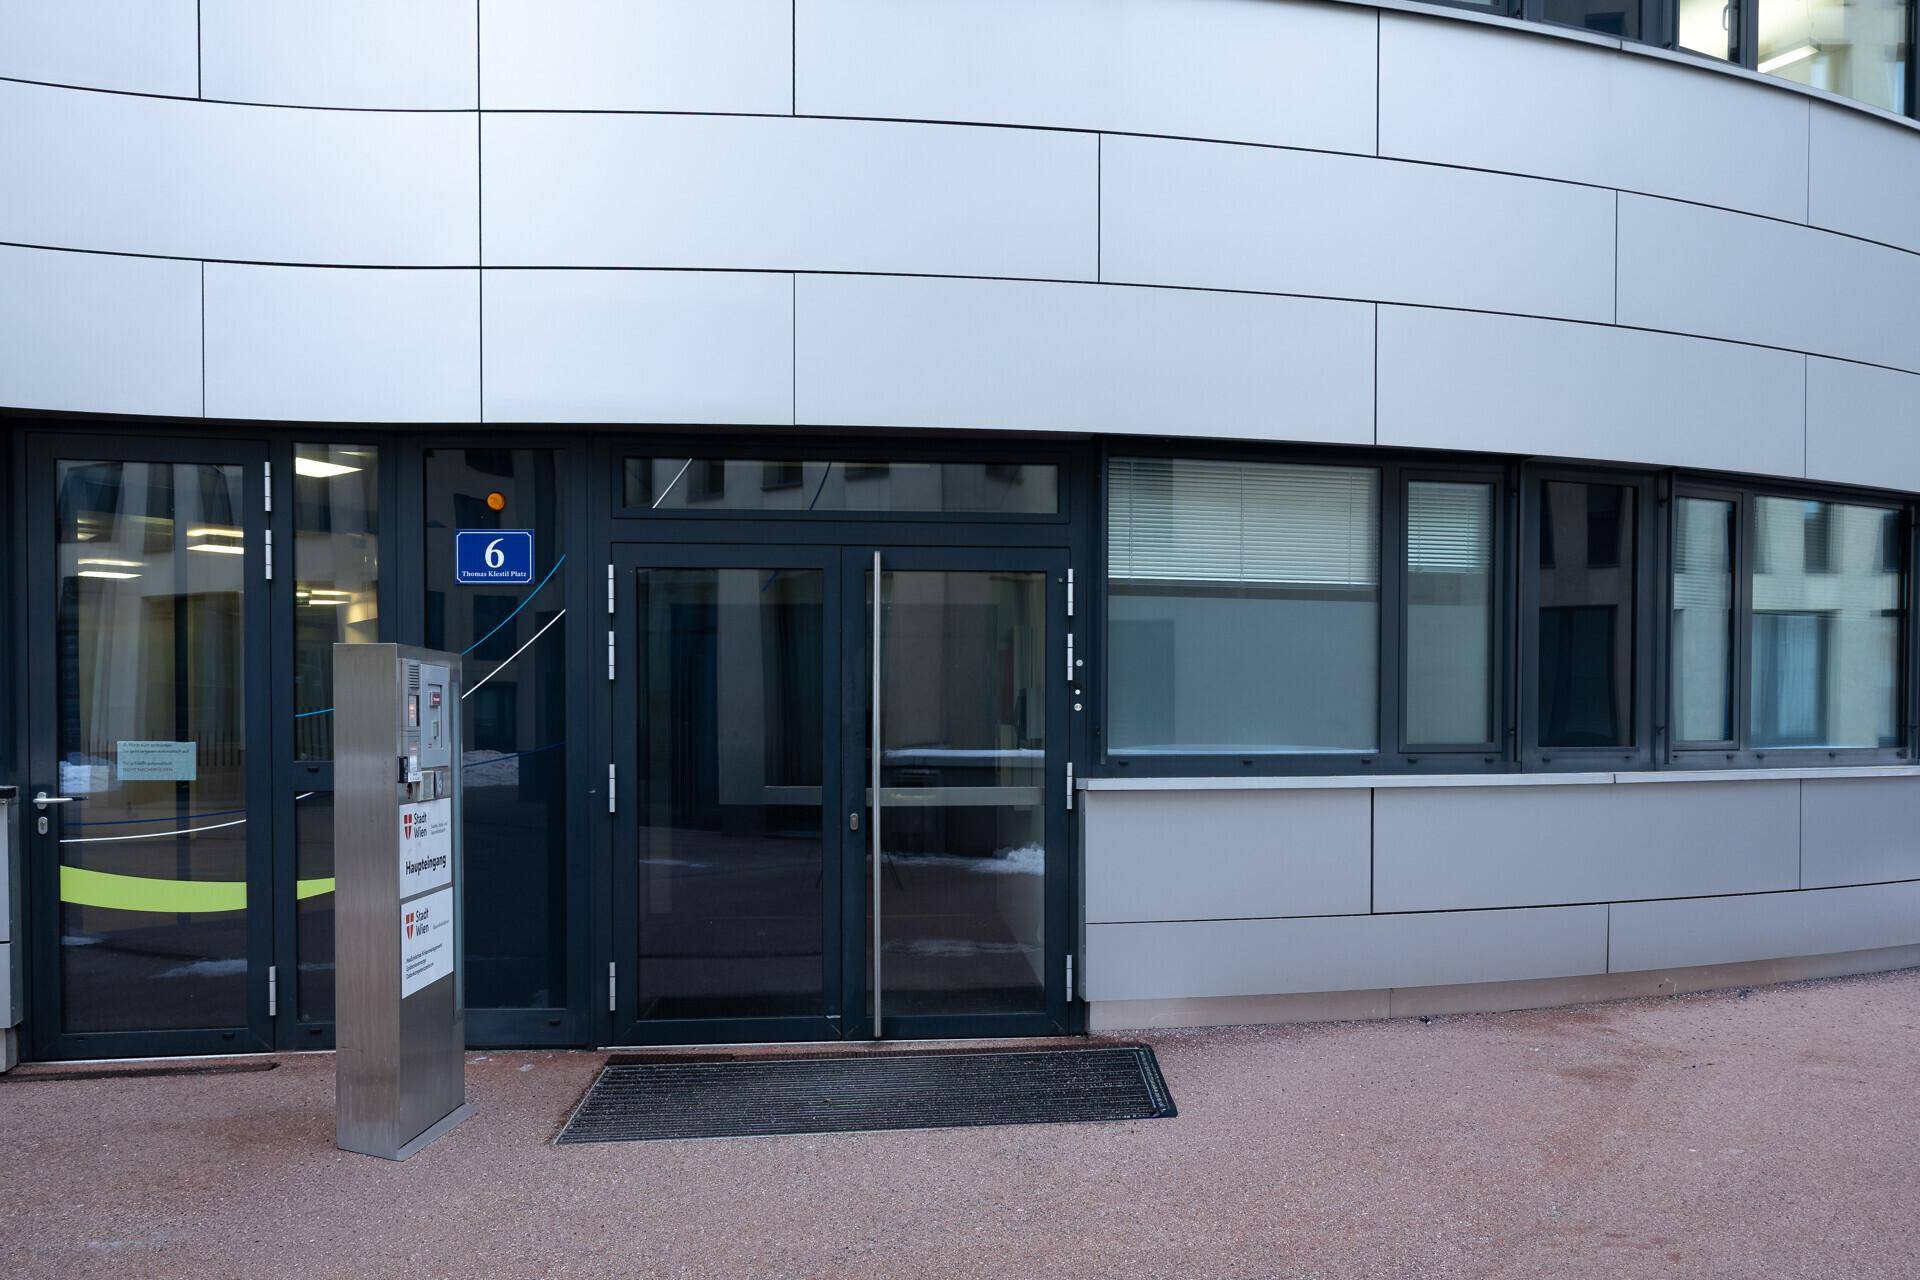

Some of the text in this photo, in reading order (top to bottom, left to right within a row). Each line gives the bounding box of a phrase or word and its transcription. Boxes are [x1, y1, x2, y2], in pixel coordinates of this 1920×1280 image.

[485, 538, 504, 568] 6
[413, 812, 427, 824] Stadt
[414, 826, 428, 838] Wien
[405, 855, 447, 876] Haupteingang
[415, 908, 429, 922] Stadt
[416, 924, 429, 936] Wien
